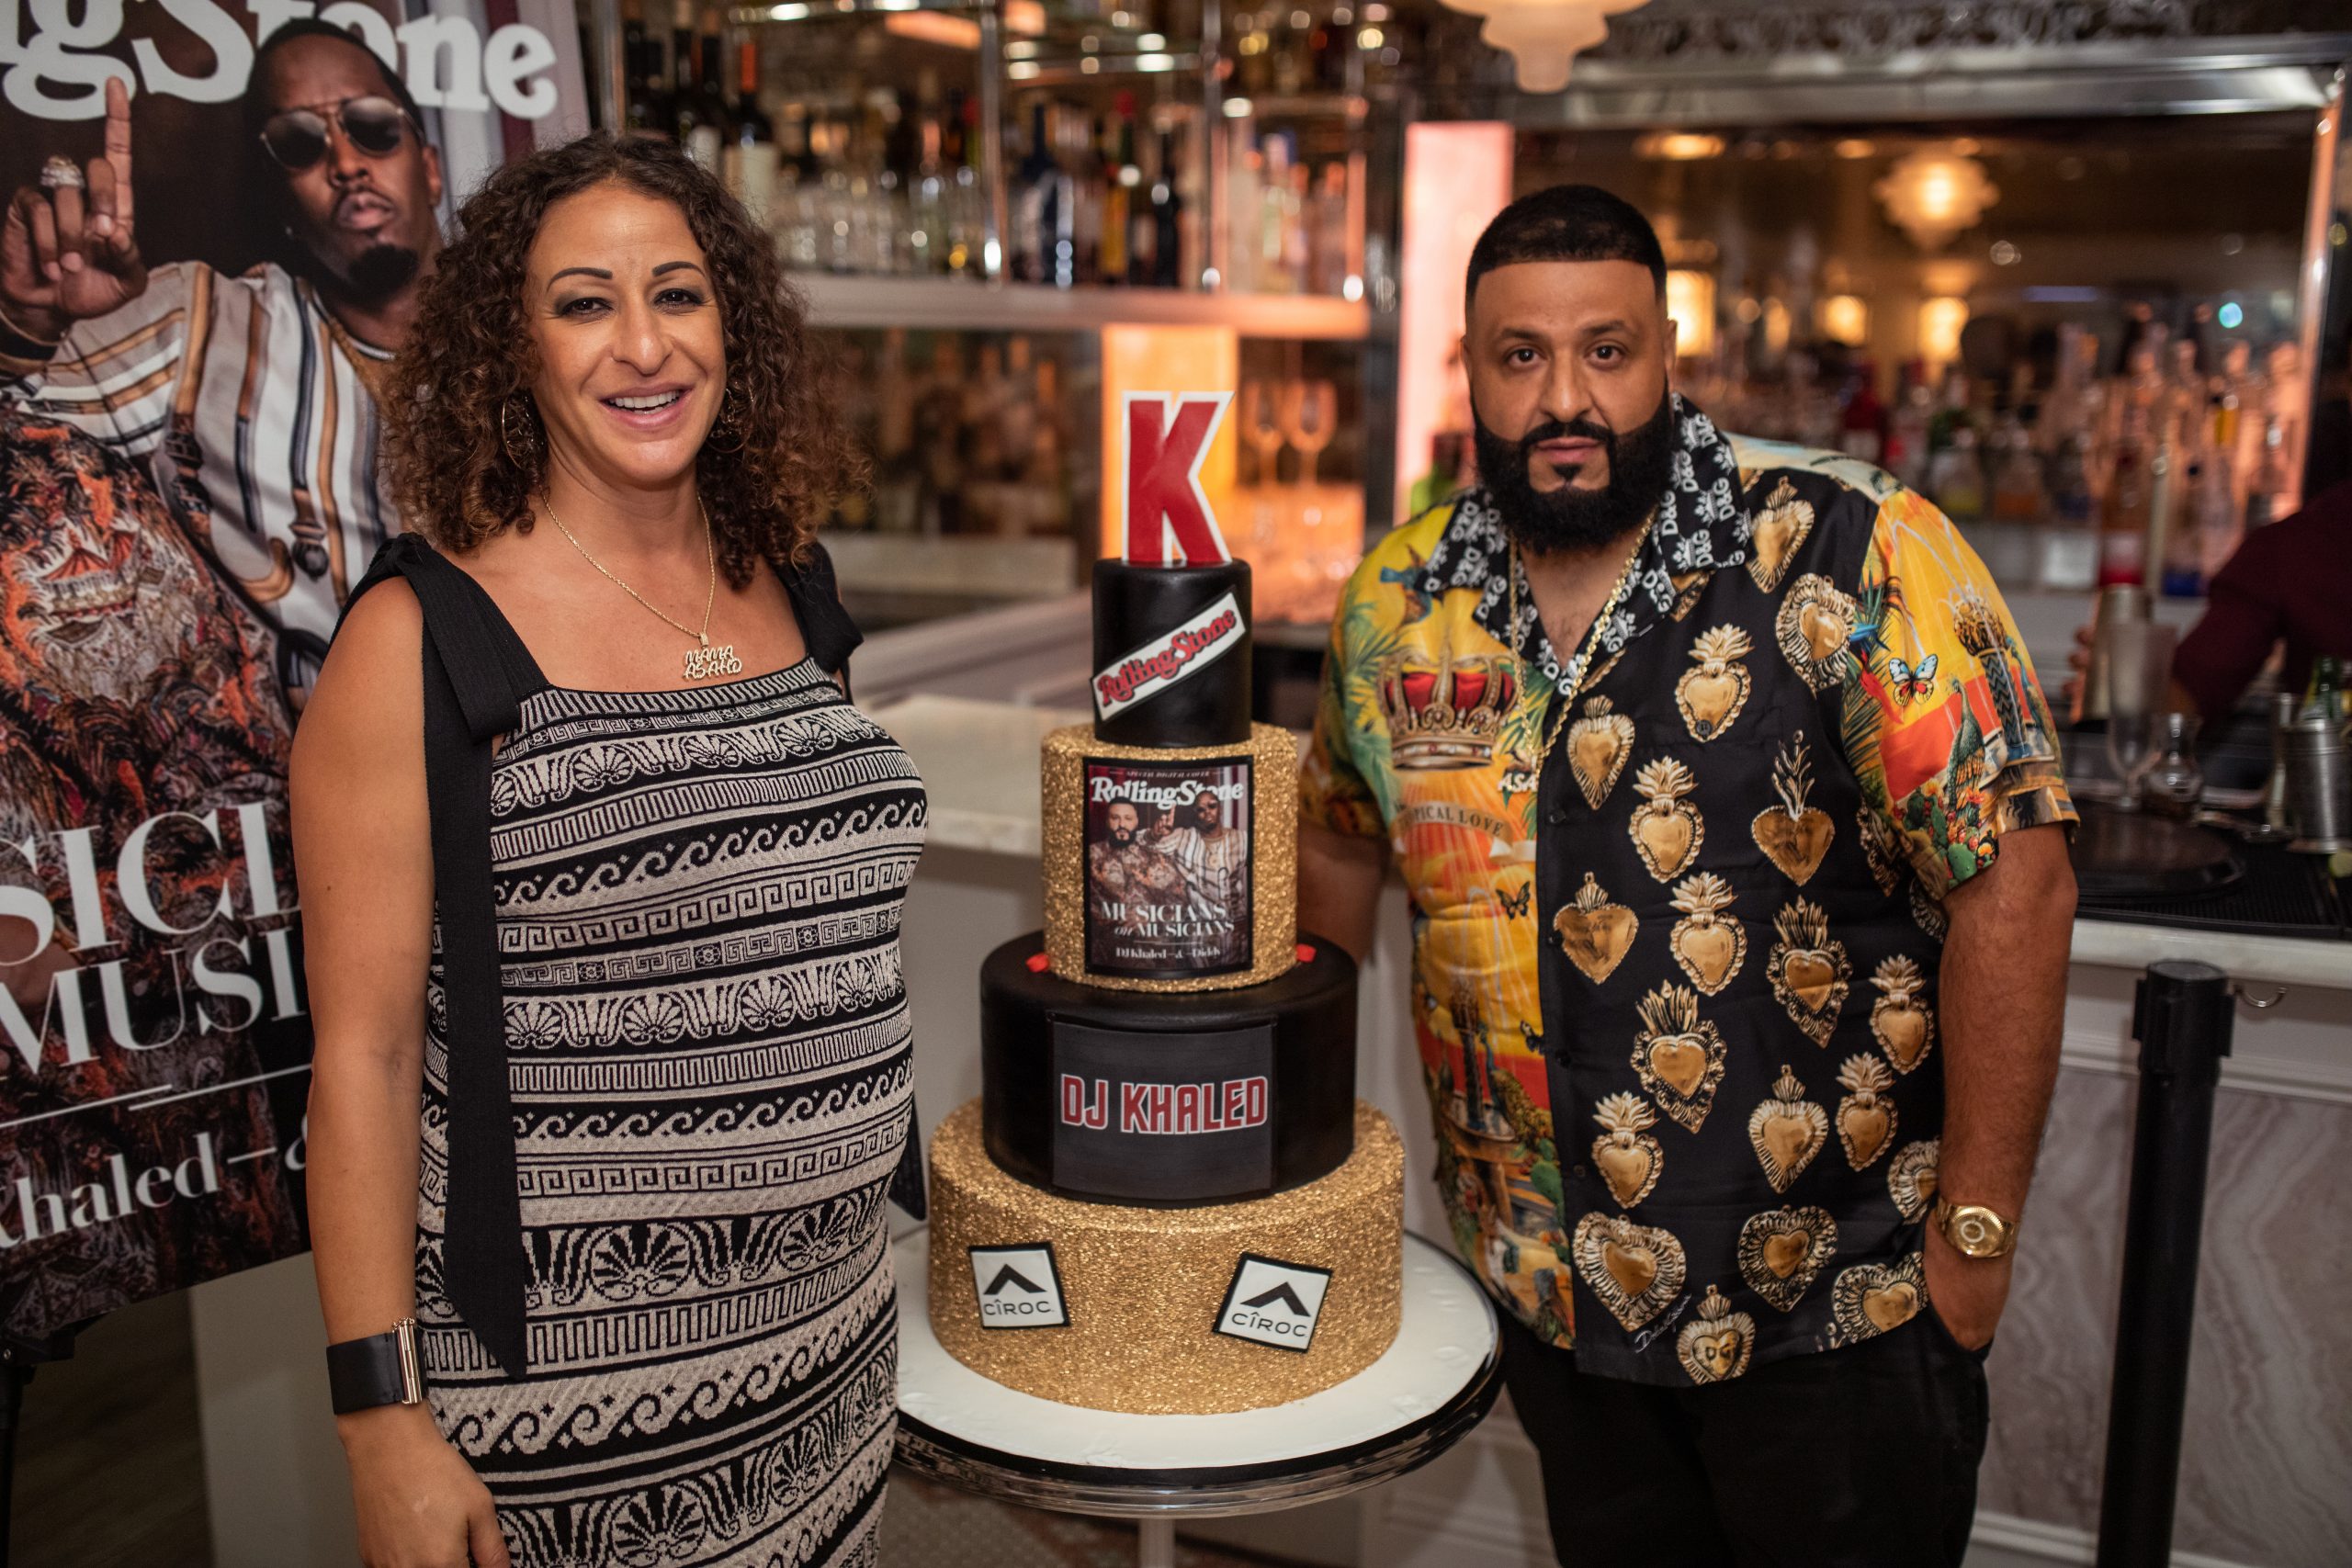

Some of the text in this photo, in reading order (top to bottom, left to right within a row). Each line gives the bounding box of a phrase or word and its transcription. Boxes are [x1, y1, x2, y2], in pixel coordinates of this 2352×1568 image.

[1122, 390, 1235, 568] K
[1712, 477, 1736, 522] D&G
[1660, 490, 1679, 536] D&G
[1692, 529, 1713, 568] D&G
[1475, 574, 1508, 620] D&G
[1642, 568, 1673, 613] D&G
[685, 644, 734, 665] MAMA
[1097, 609, 1238, 707] RollingStone
[1458, 809, 1503, 837] LOVE
[1102, 901, 1227, 923] MUSICIANS
[1137, 919, 1235, 938] MUSICIANS
[1061, 1073, 1269, 1135] DJ KHALED
